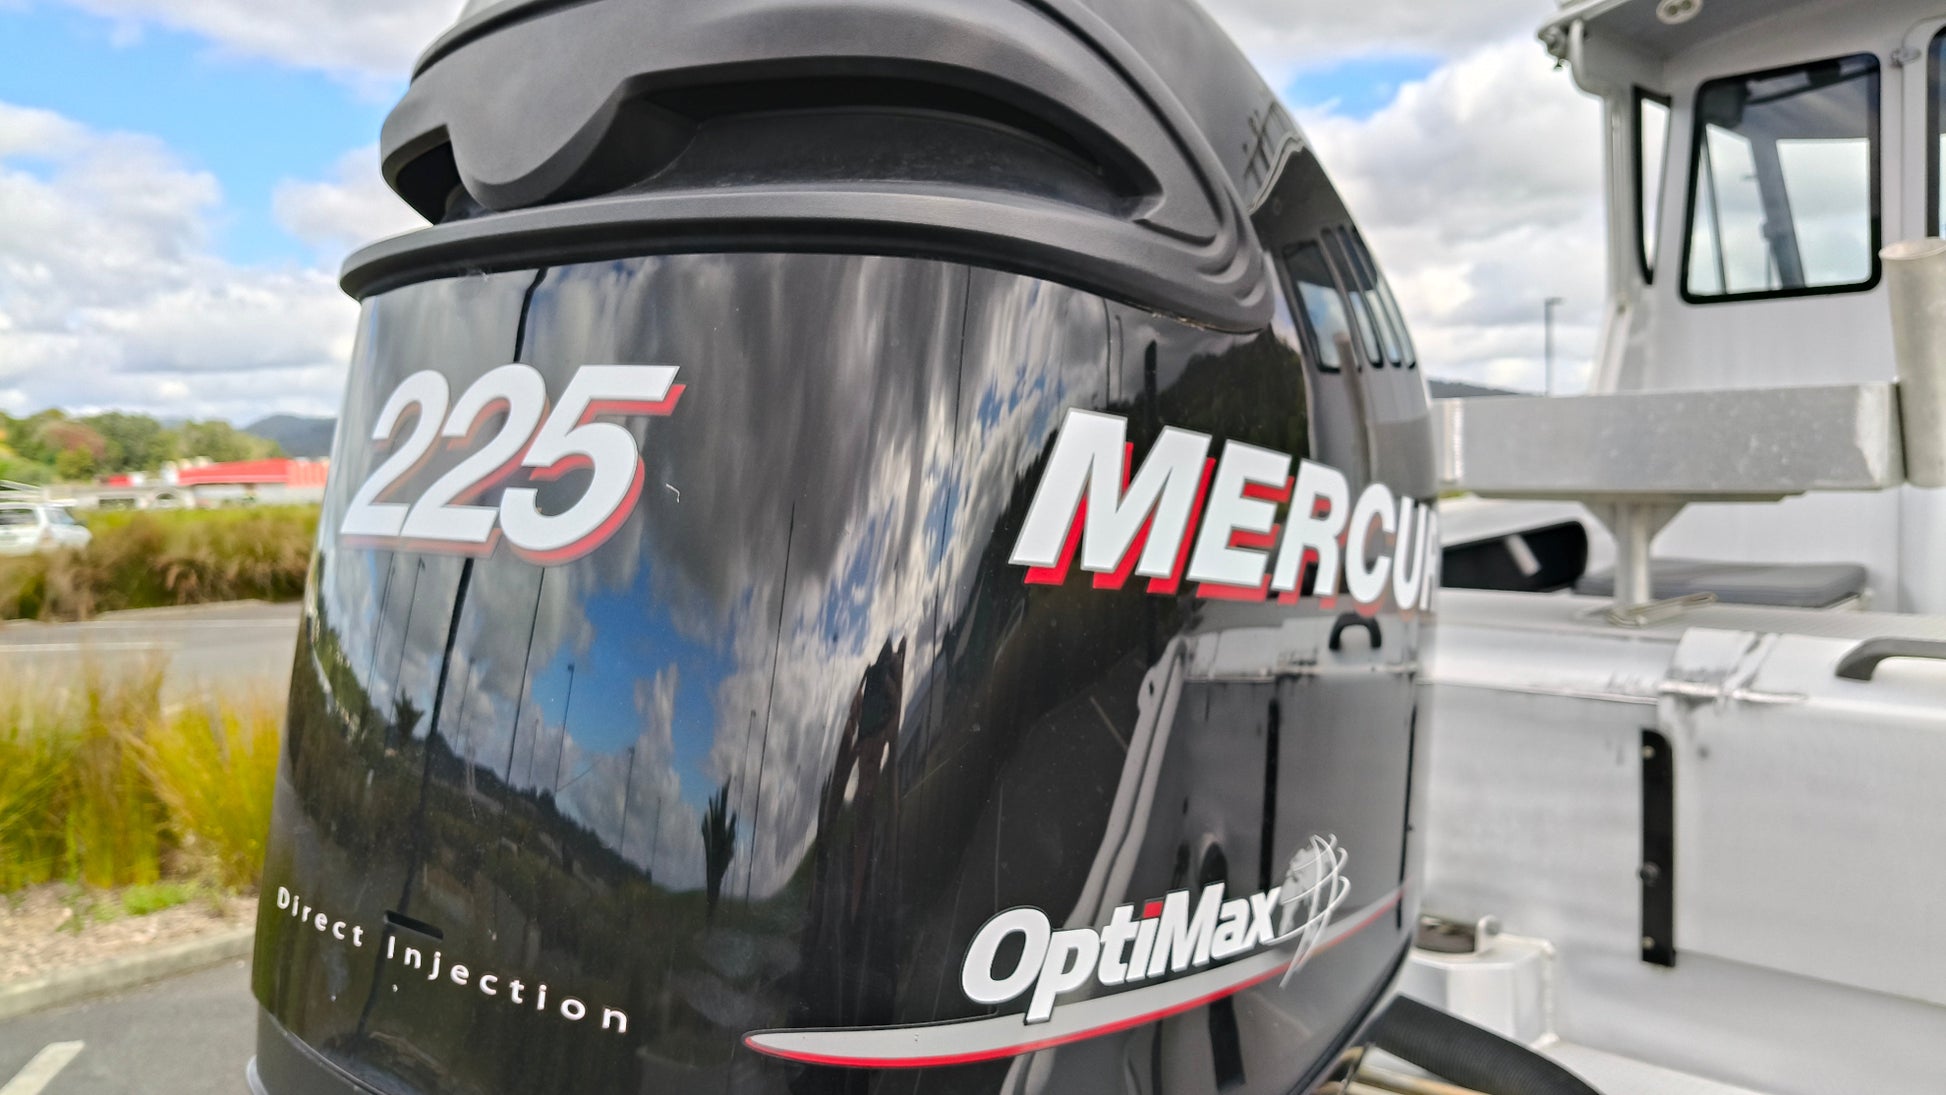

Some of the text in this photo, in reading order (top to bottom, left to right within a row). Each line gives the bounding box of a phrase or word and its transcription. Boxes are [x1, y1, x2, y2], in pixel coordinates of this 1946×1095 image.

[341, 363, 686, 566] 225
[276, 886, 628, 1034] Direct Injection
[961, 882, 1282, 1025] OptiMax
